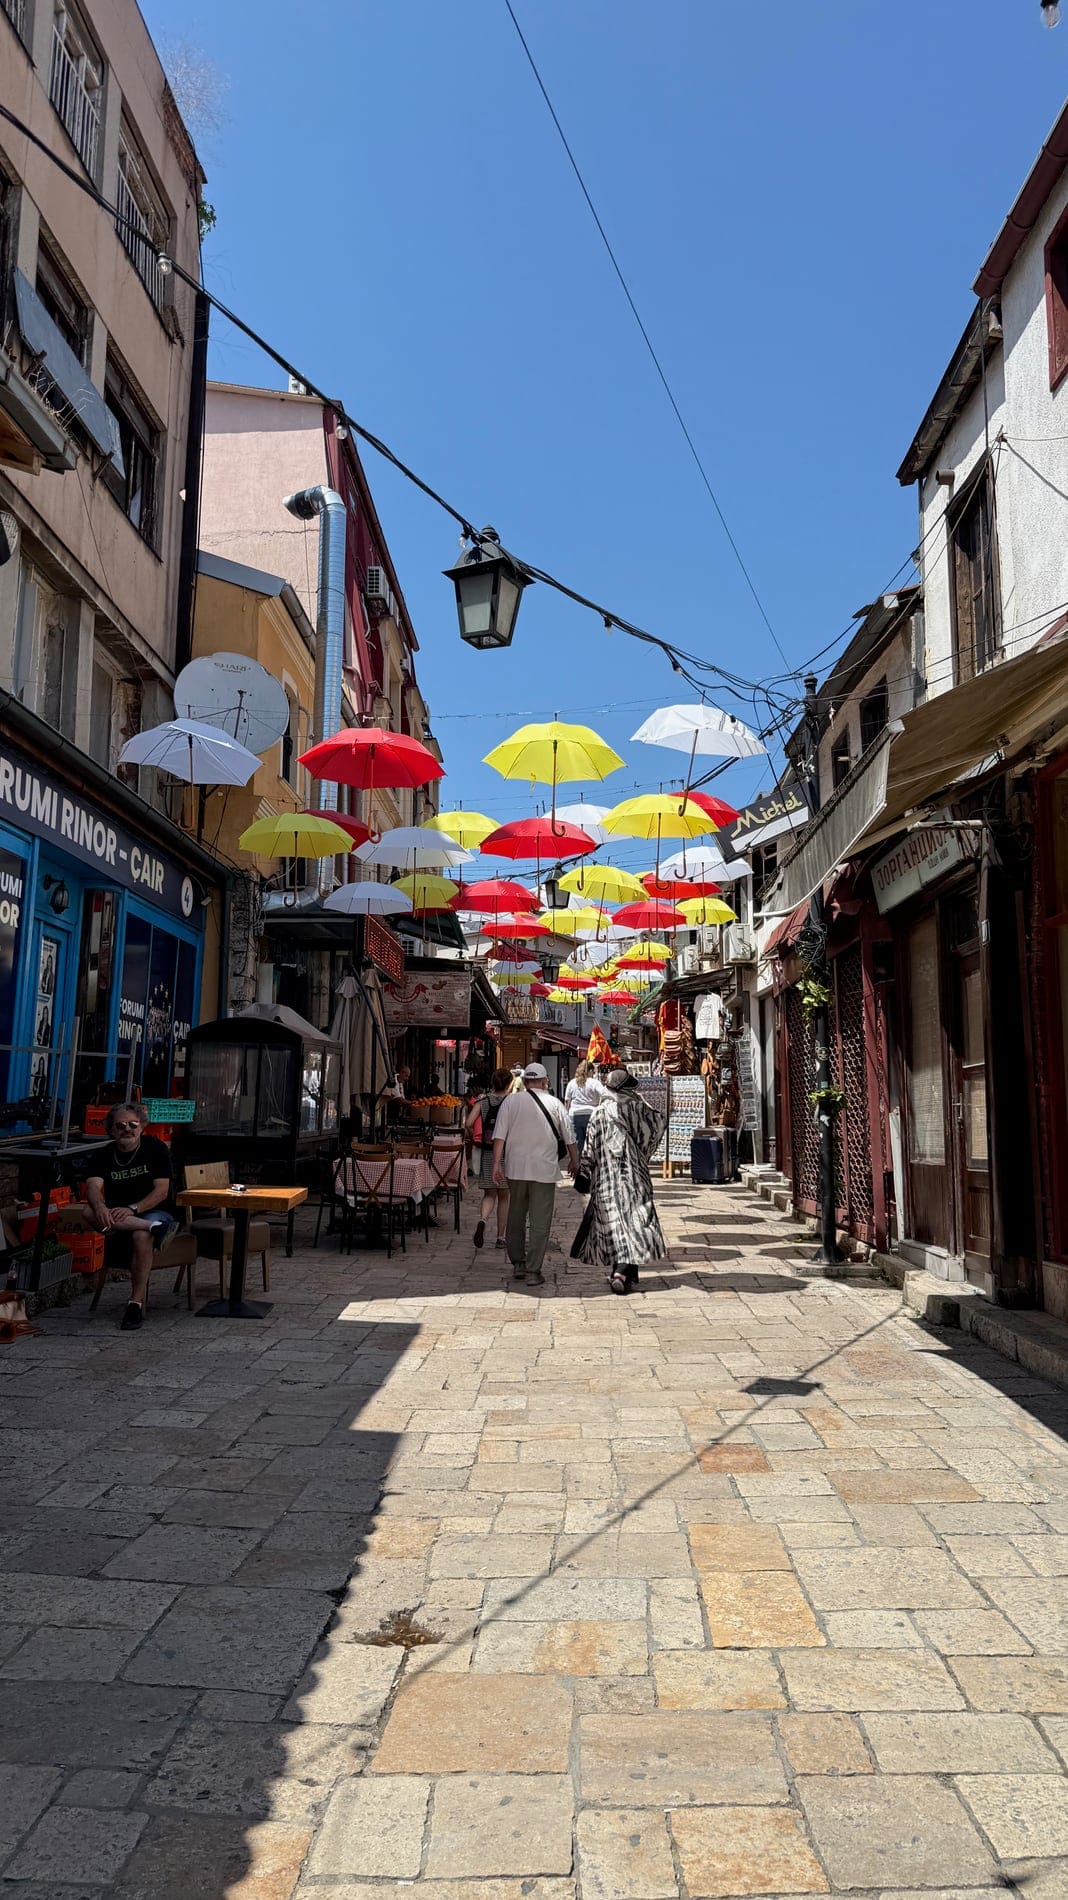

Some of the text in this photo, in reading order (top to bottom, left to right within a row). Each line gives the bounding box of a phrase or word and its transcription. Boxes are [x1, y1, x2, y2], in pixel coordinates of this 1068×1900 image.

[61, 797, 117, 866] RINOR
[119, 848, 127, 861] -
[130, 846, 165, 894] ÇAIR
[0, 871, 23, 898] UMI
[111, 1165, 150, 1179] DIESEL
